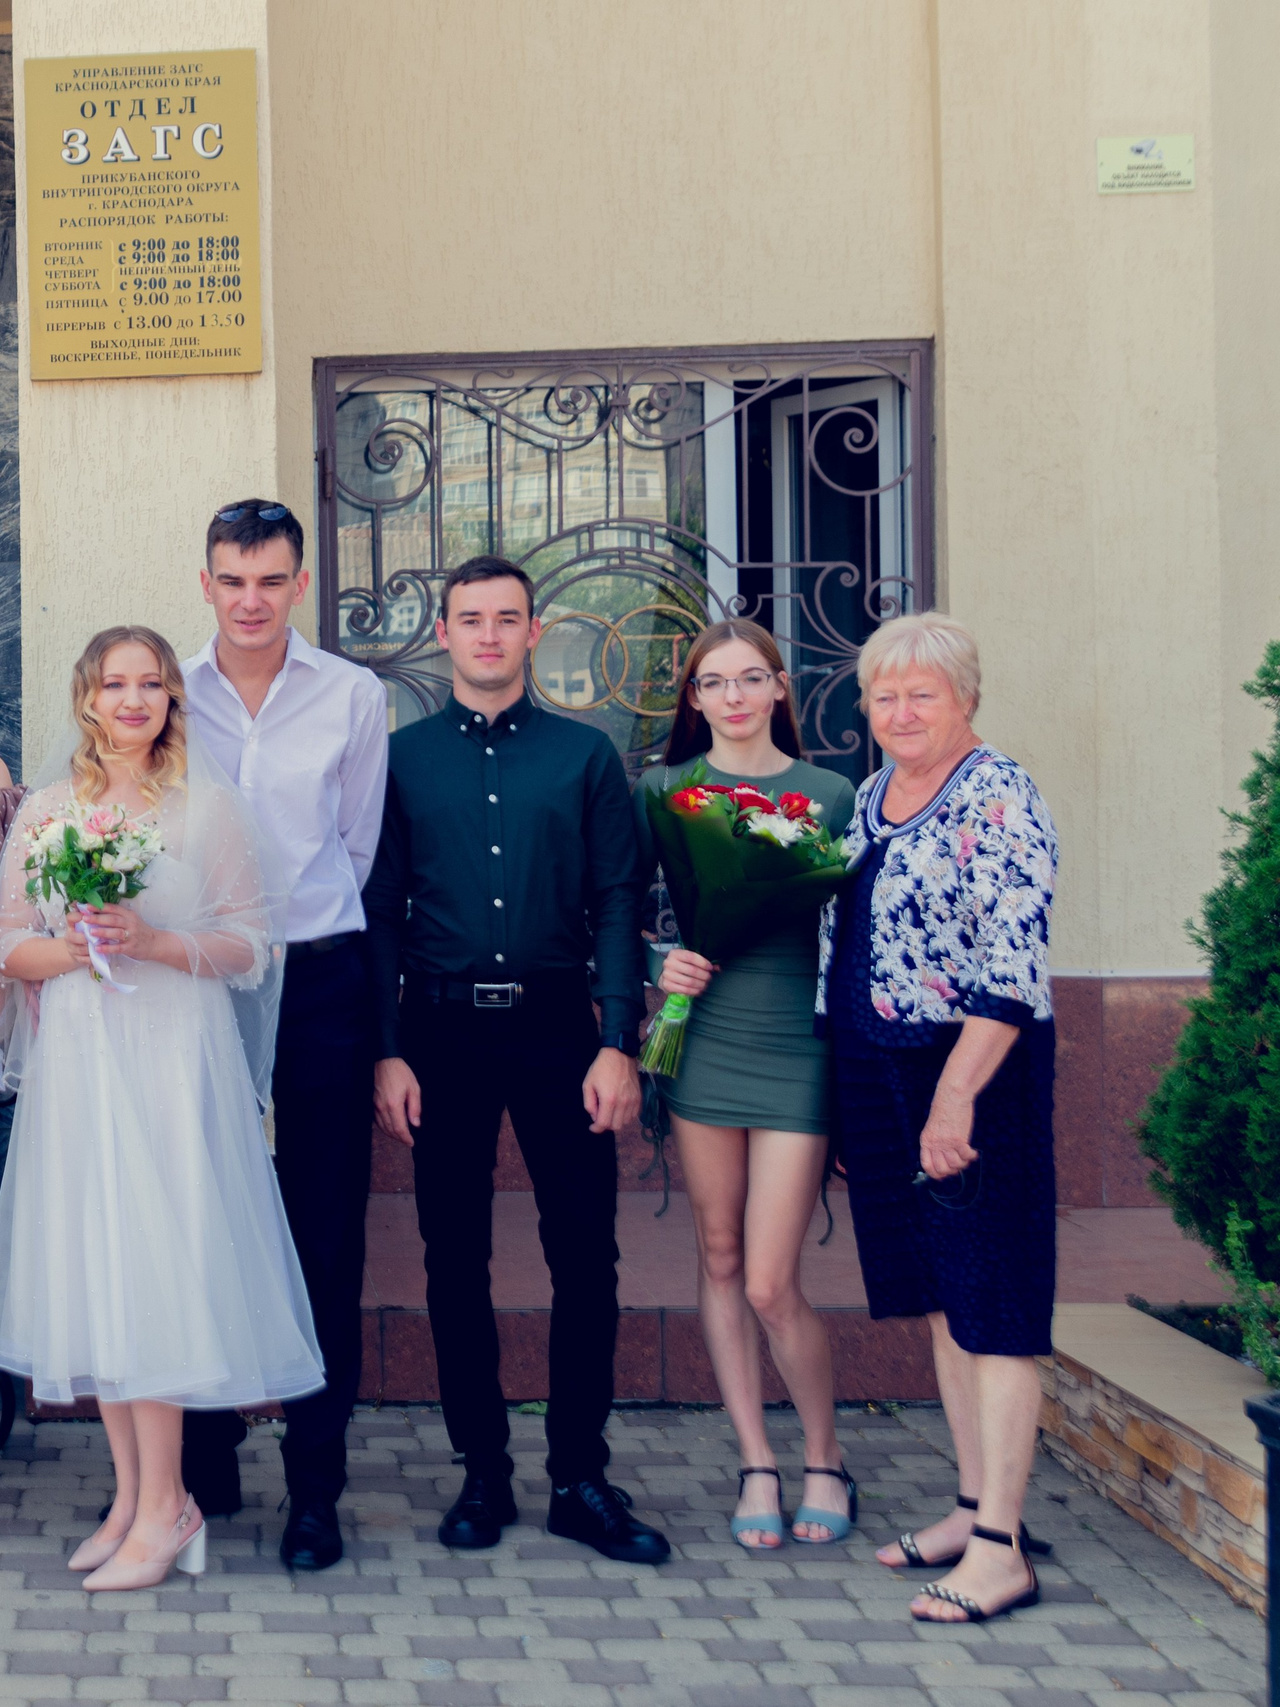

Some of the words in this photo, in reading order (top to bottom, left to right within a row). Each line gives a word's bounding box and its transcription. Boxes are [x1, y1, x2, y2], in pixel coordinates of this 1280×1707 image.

[73, 65, 166, 78] УПРАВЛЕНИЕ
[170, 64, 204, 74] ЗАГС
[55, 78, 180, 92] КРАСНОДАРСКОГО
[185, 77, 221, 86] КРАЯ
[80, 96, 197, 120] ОТДЕЛ
[61, 122, 223, 164] ЗАГС
[81, 170, 200, 184] ПРИКУБАНСКОГО
[42, 184, 183, 199] ВНУТРИГОРОДСКОГО
[186, 182, 240, 193] ОКРУГА
[102, 197, 193, 209] КРАСНОДАРА
[59, 215, 155, 228] РАСПОРЯДОК
[165, 213, 229, 224] РАБОТЫ:
[44, 241, 103, 251] ВТОРНИК
[132, 238, 165, 251] 9:00
[172, 240, 190, 251] до
[198, 235, 239, 248] 18:00
[44, 256, 84, 267] СРЕДА
[132, 251, 165, 264] 9:00
[172, 253, 190, 263] до
[198, 248, 239, 261] 18:00
[45, 269, 99, 279] ЧЕТВЕРГ
[120, 264, 205, 275] НЕПРИЕМНЫЙ
[209, 264, 240, 273] ДЕНЬ
[44, 281, 101, 291] СУББОТА
[133, 277, 167, 290] 9:00
[173, 279, 191, 290] до
[199, 275, 240, 288] 18:00
[46, 299, 108, 309] ПЯТНИЦА
[133, 291, 169, 306] 9.00
[174, 295, 191, 306] до
[196, 289, 242, 303] 17.00
[46, 321, 105, 331] ПЕРЕРЫВ
[127, 315, 172, 329] 13.00
[177, 319, 193, 329] до
[90, 339, 166, 350] ВЫХОДНЫЕ
[170, 337, 200, 347] ДНИ:
[50, 351, 141, 363] ВОСКРЕСЕНЬЕ,
[146, 348, 241, 359] ПОНЕДЕЛЬНИК
